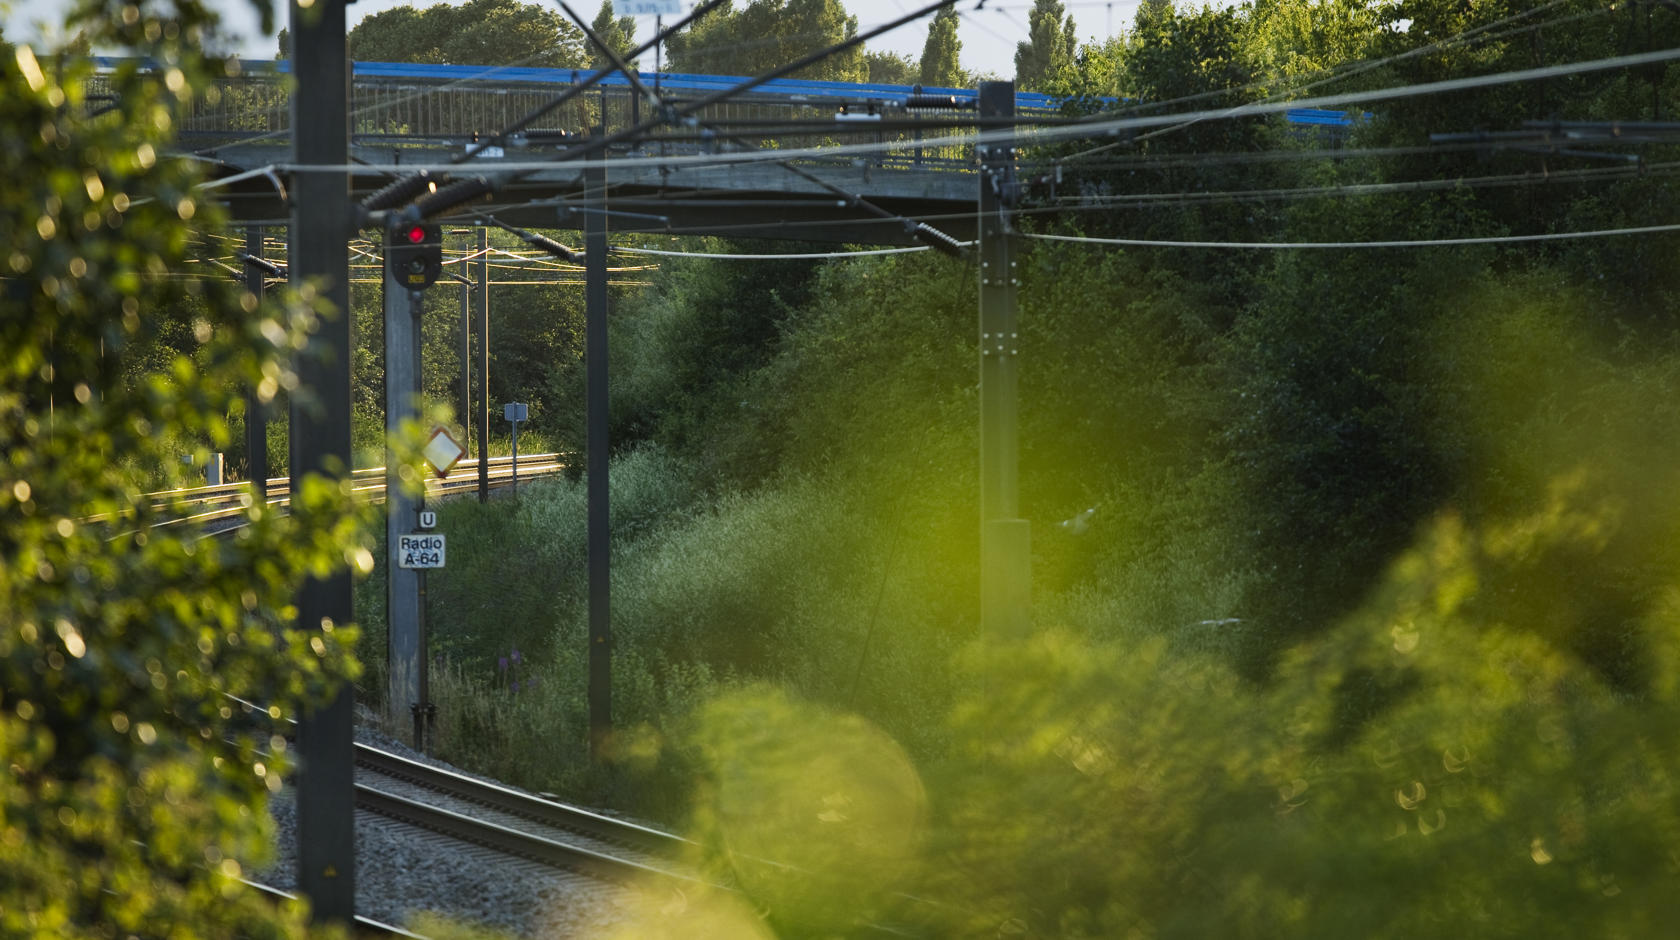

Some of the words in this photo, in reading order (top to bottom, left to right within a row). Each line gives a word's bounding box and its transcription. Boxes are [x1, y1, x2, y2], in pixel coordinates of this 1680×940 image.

[423, 513, 433, 526] U
[401, 537, 442, 550] Radio
[404, 552, 440, 565] A-64
